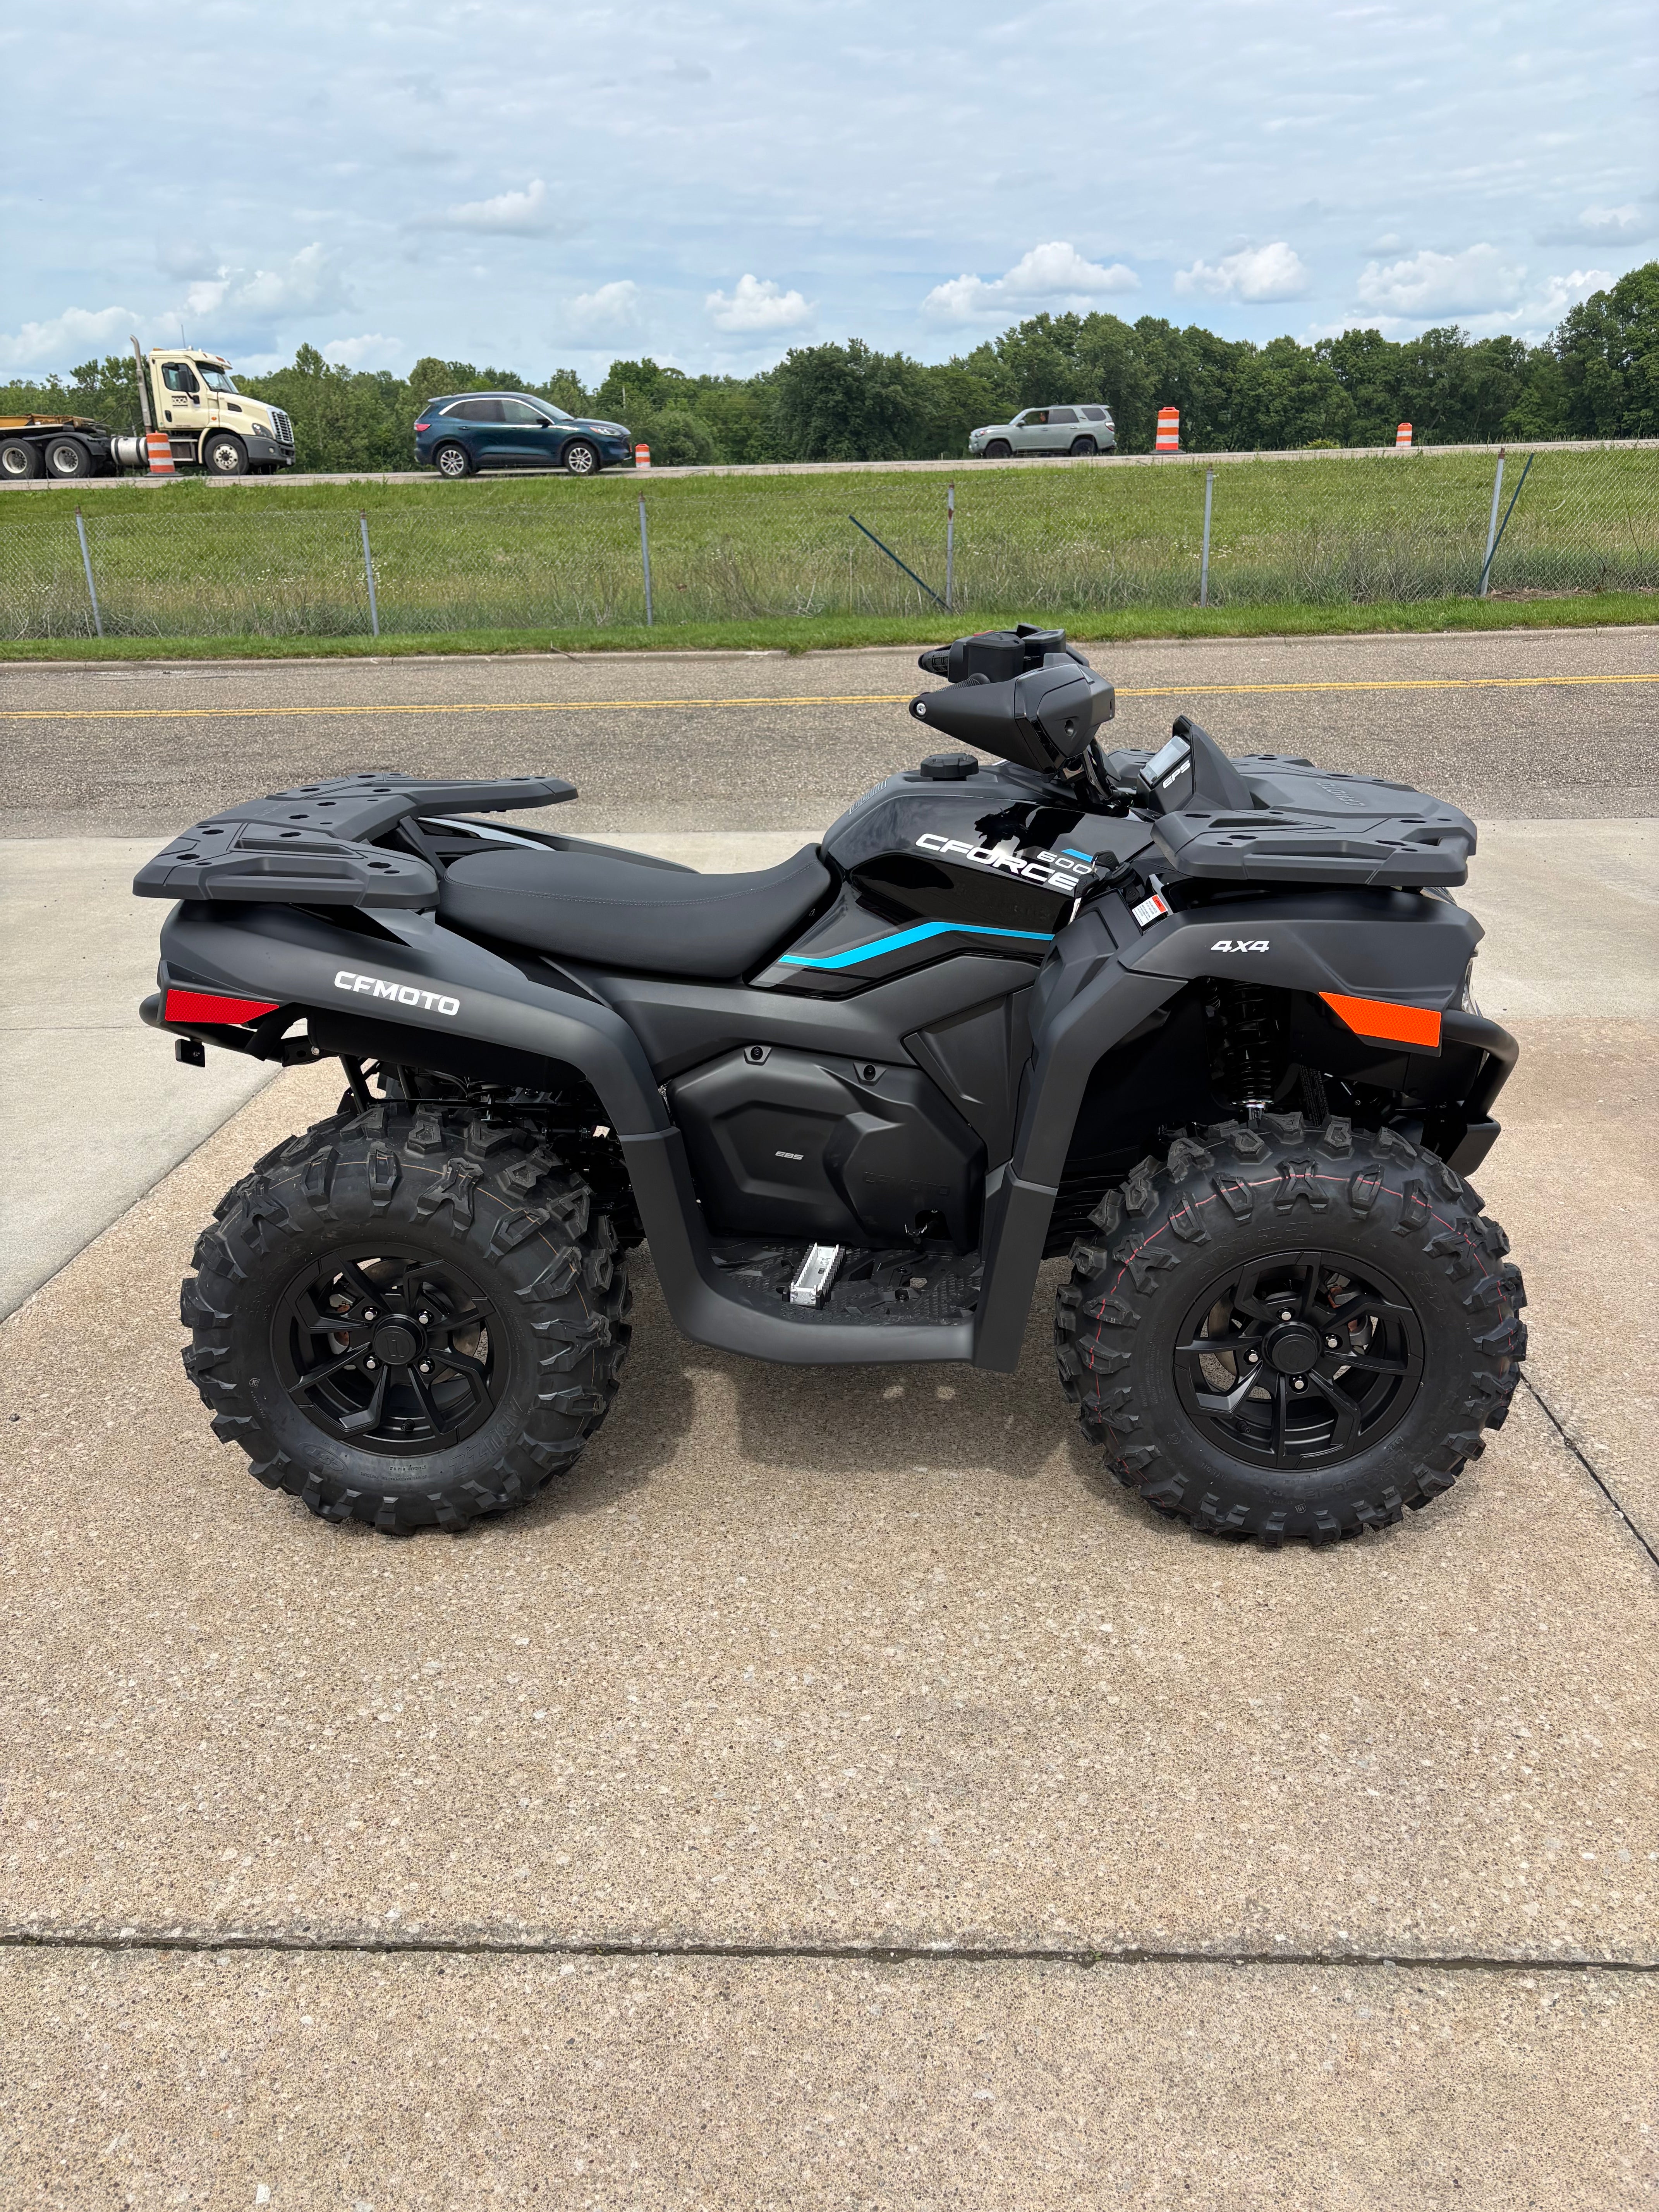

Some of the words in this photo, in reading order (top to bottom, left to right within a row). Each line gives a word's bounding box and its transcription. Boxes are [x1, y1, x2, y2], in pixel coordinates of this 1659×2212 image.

[1163, 759, 1190, 789] EPS
[915, 833, 1079, 891] CFORCE
[1037, 850, 1093, 875] 600
[1211, 940, 1269, 952] 4X4
[334, 971, 460, 1016] CFMOTO
[775, 1151, 804, 1160] EBS
[449, 1395, 523, 1478] ABUZZ
[304, 1445, 345, 1472] CST
